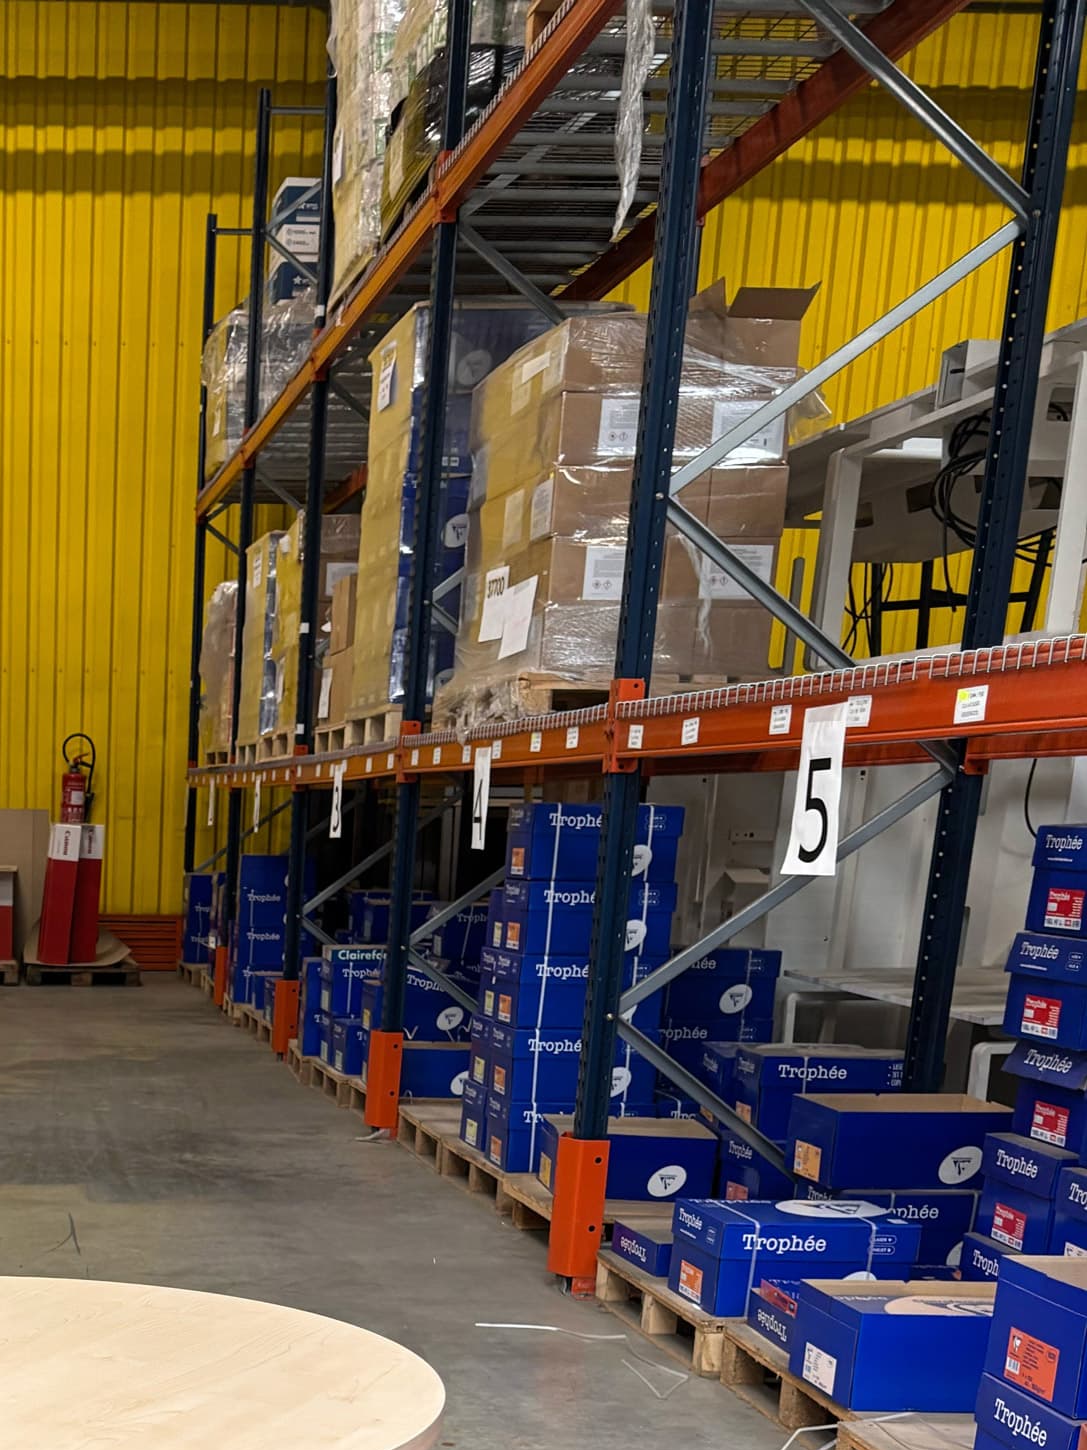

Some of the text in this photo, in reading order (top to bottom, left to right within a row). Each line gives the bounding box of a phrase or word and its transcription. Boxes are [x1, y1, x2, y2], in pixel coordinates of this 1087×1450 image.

[798, 757, 831, 863] 5
[1046, 834, 1083, 852] Trophée
[1020, 941, 1059, 960] Trophée
[778, 1064, 848, 1081] Trophée
[1024, 1049, 1072, 1074] Trophée
[728, 1140, 753, 1159] Trophée
[996, 1149, 1038, 1179] Trophée
[1068, 1183, 1087, 1211] Tro
[679, 1207, 703, 1230] Trophée
[620, 1236, 647, 1263] Trophée
[742, 1234, 827, 1255] Trophée
[973, 1249, 999, 1278] Troph
[757, 1308, 788, 1342] Trophée
[993, 1398, 1047, 1448] Trophée
